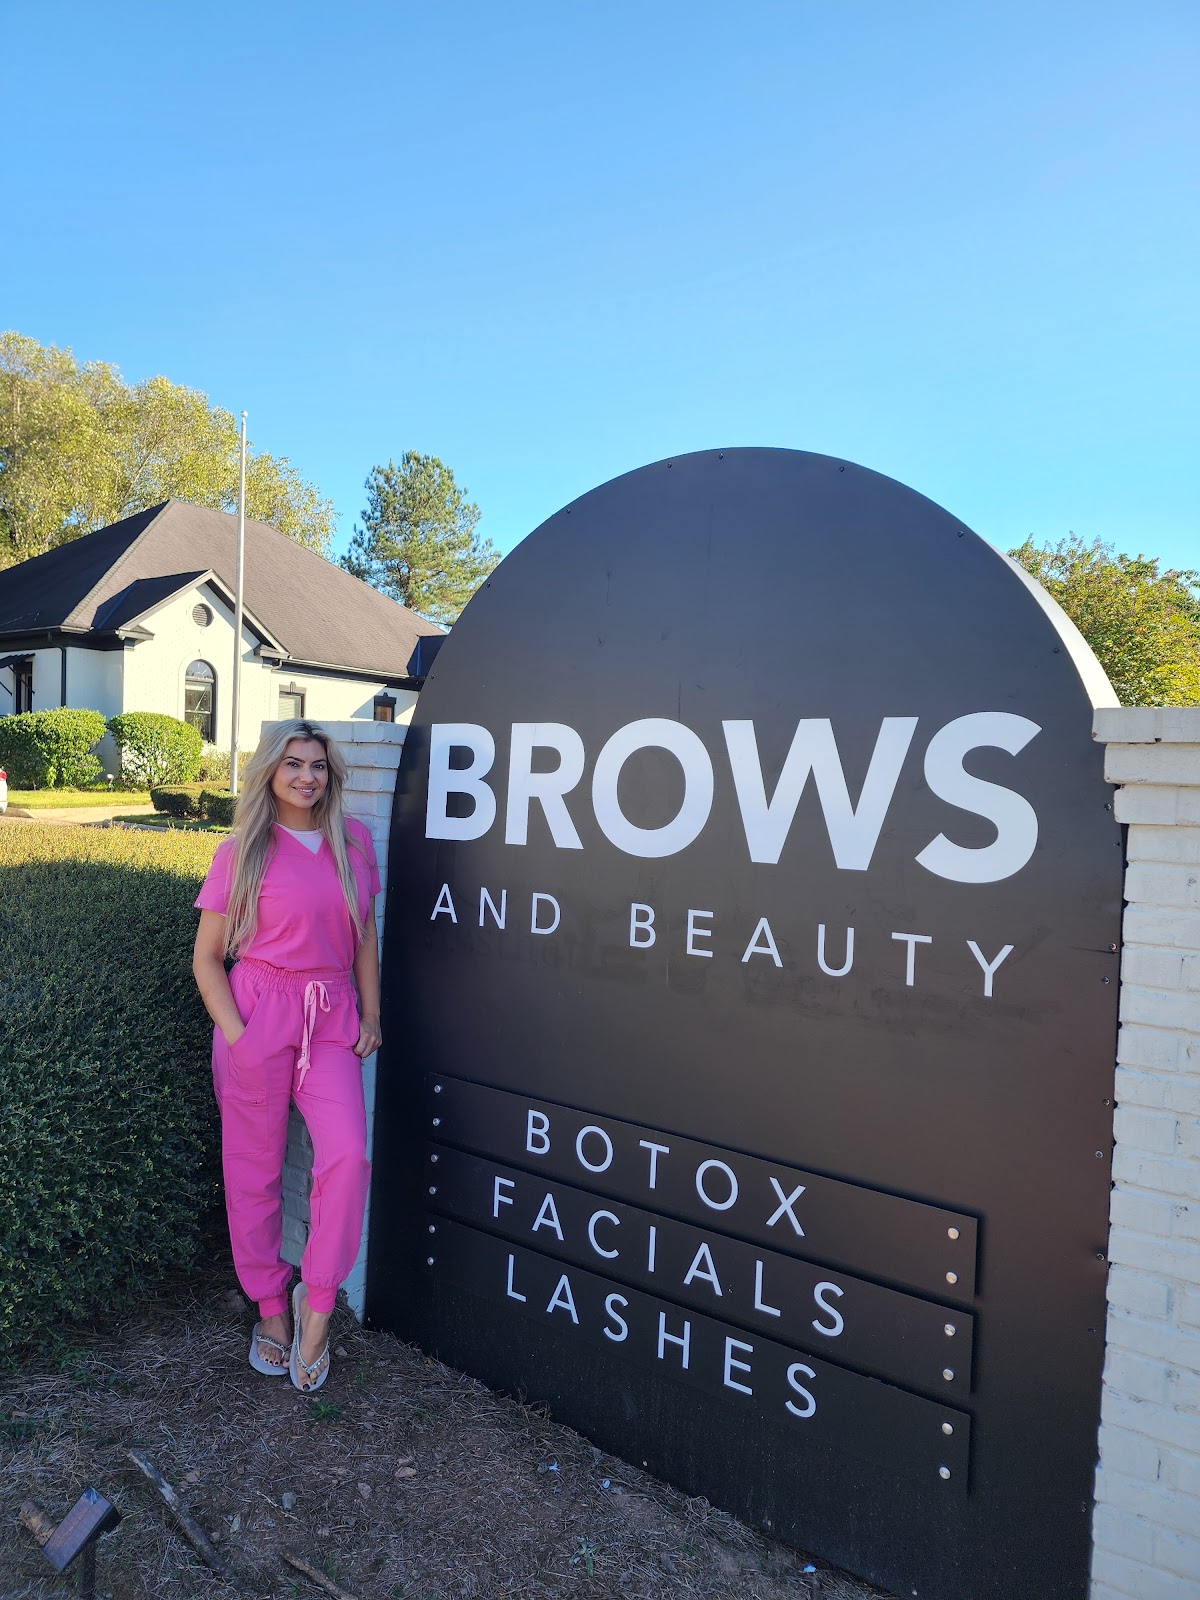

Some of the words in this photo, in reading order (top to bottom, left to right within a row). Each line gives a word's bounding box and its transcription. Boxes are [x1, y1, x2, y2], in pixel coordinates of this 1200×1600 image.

[425, 712, 1043, 884] BROWS
[430, 883, 561, 935] AND
[629, 902, 1015, 998] BEAUTY
[526, 1109, 807, 1237] BOTOX
[493, 1175, 845, 1337] FACIALS
[507, 1253, 818, 1418] LASHES
